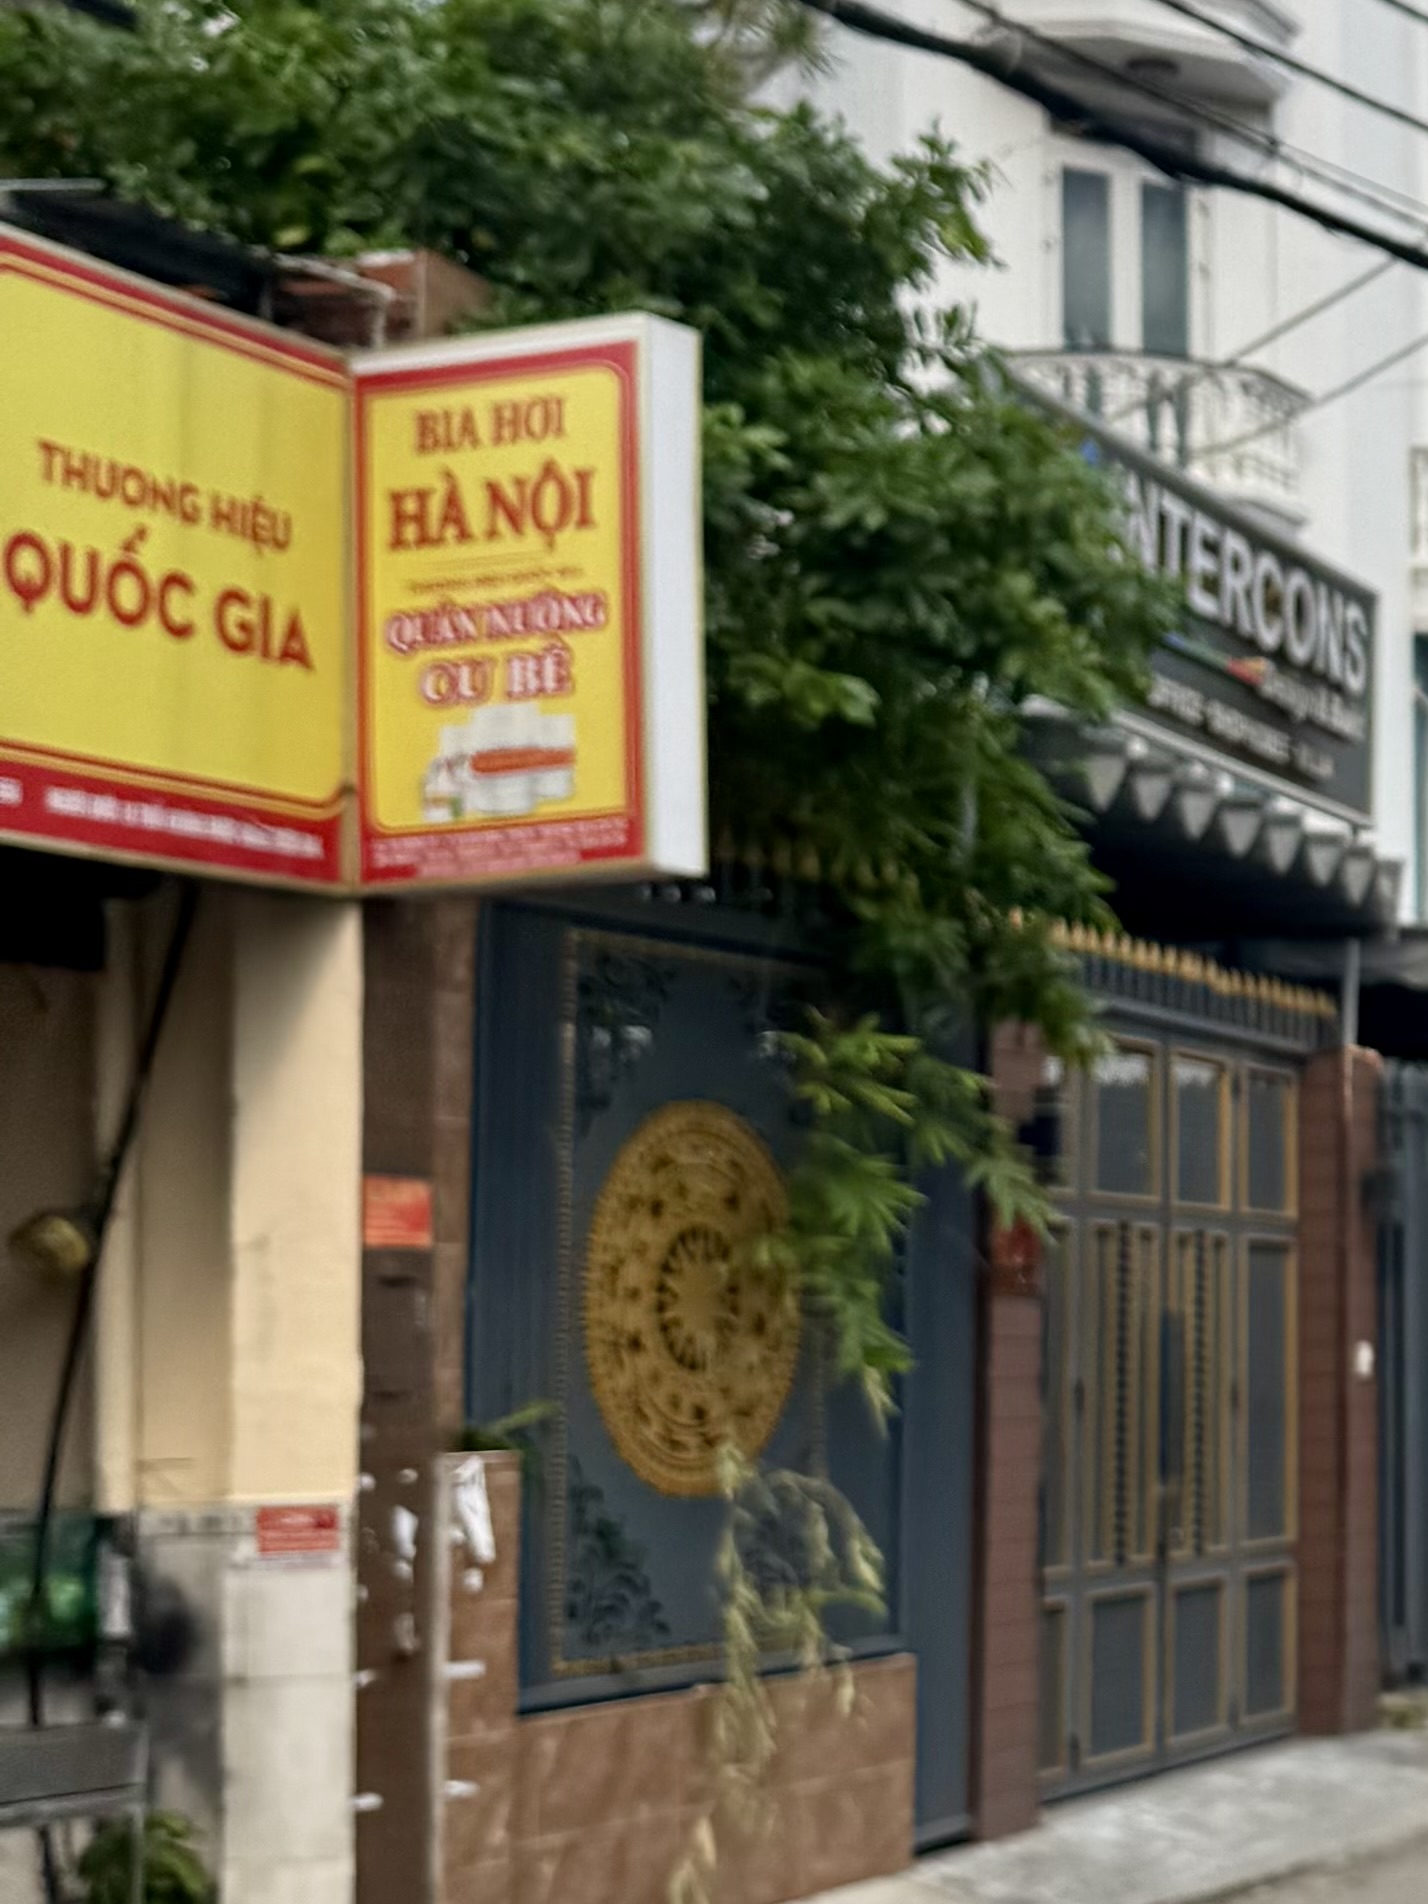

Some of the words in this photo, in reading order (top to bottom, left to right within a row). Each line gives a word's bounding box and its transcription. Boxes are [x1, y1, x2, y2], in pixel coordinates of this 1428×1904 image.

[415, 406, 481, 456] BIA
[388, 466, 473, 552] HÀ
[484, 458, 596, 549] NỘI
[4, 523, 196, 639] QUỐC
[214, 585, 314, 670] GIA
